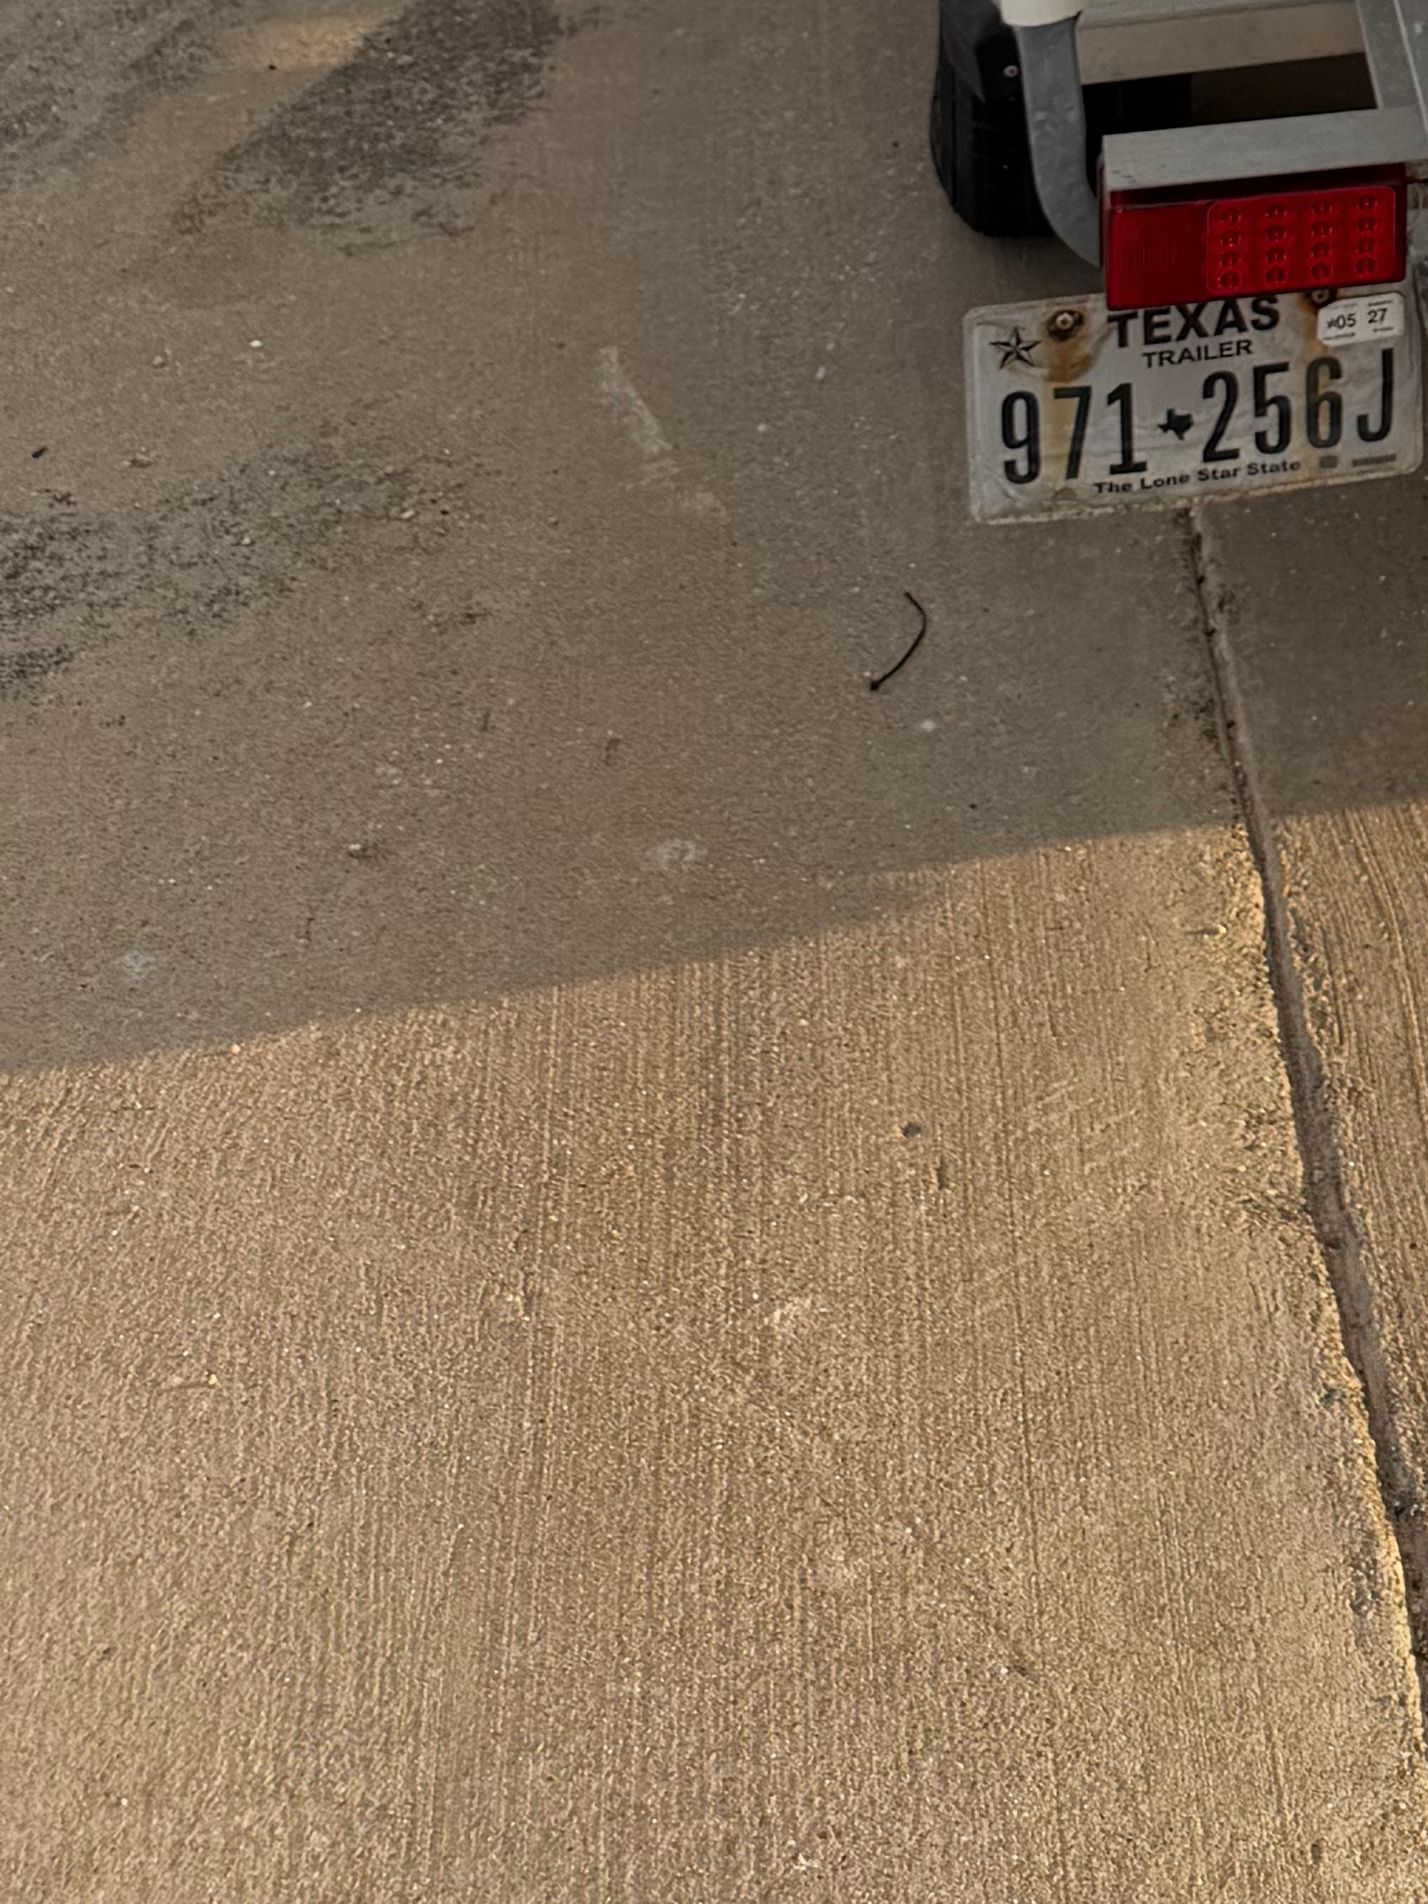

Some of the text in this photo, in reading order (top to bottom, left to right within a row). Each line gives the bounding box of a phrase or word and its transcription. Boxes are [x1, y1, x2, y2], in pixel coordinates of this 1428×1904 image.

[1106, 294, 1280, 348] TEXAS
[1367, 308, 1388, 324] 27
[1142, 339, 1254, 369] TRAILER
[1093, 459, 1301, 493] The Lone Star State
